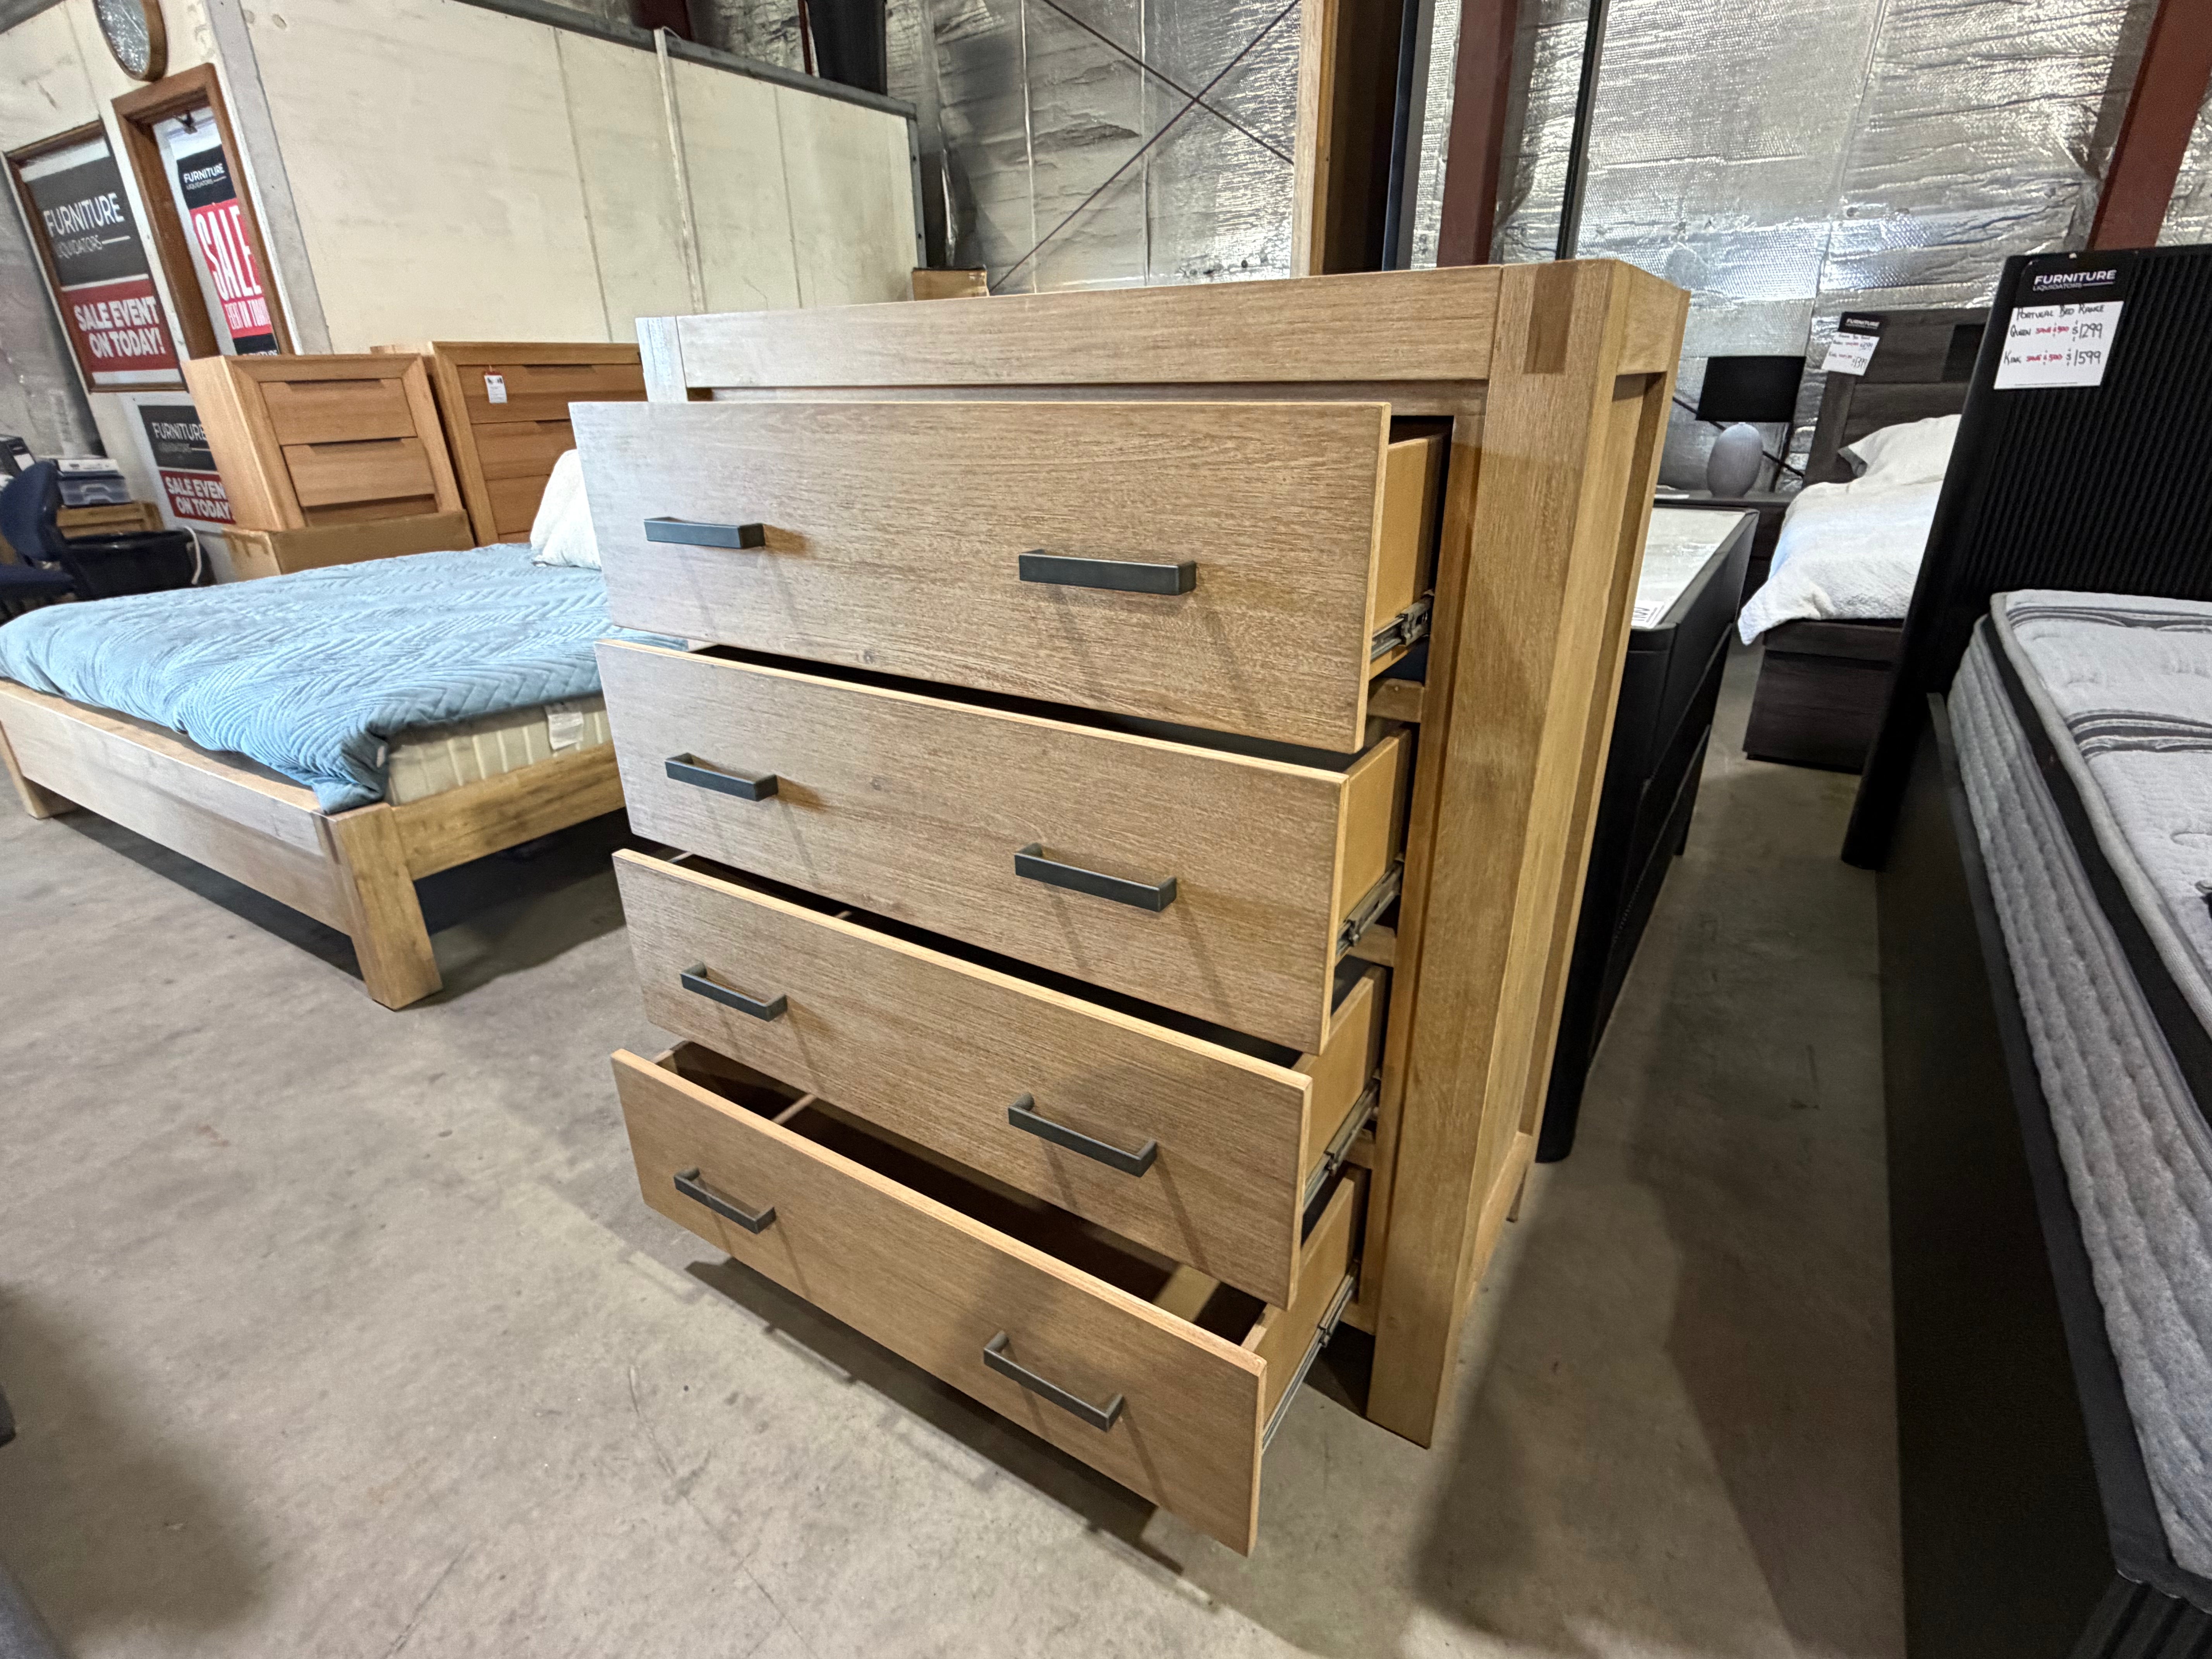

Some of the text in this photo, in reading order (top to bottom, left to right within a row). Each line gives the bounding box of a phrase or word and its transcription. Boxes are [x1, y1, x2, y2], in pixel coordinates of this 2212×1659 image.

[184, 163, 225, 183] FURNITURE
[43, 192, 125, 237] FURNITURE
[196, 205, 262, 301] SALE
[2034, 270, 2117, 285] FURNITURE
[74, 295, 160, 331] SALE EVENT
[89, 327, 166, 359] ON TODAY!
[2066, 348, 2101, 366] $1599
[152, 422, 207, 441] FURNITURE
[165, 476, 195, 496] SALE
[176, 496, 194, 515] ON
